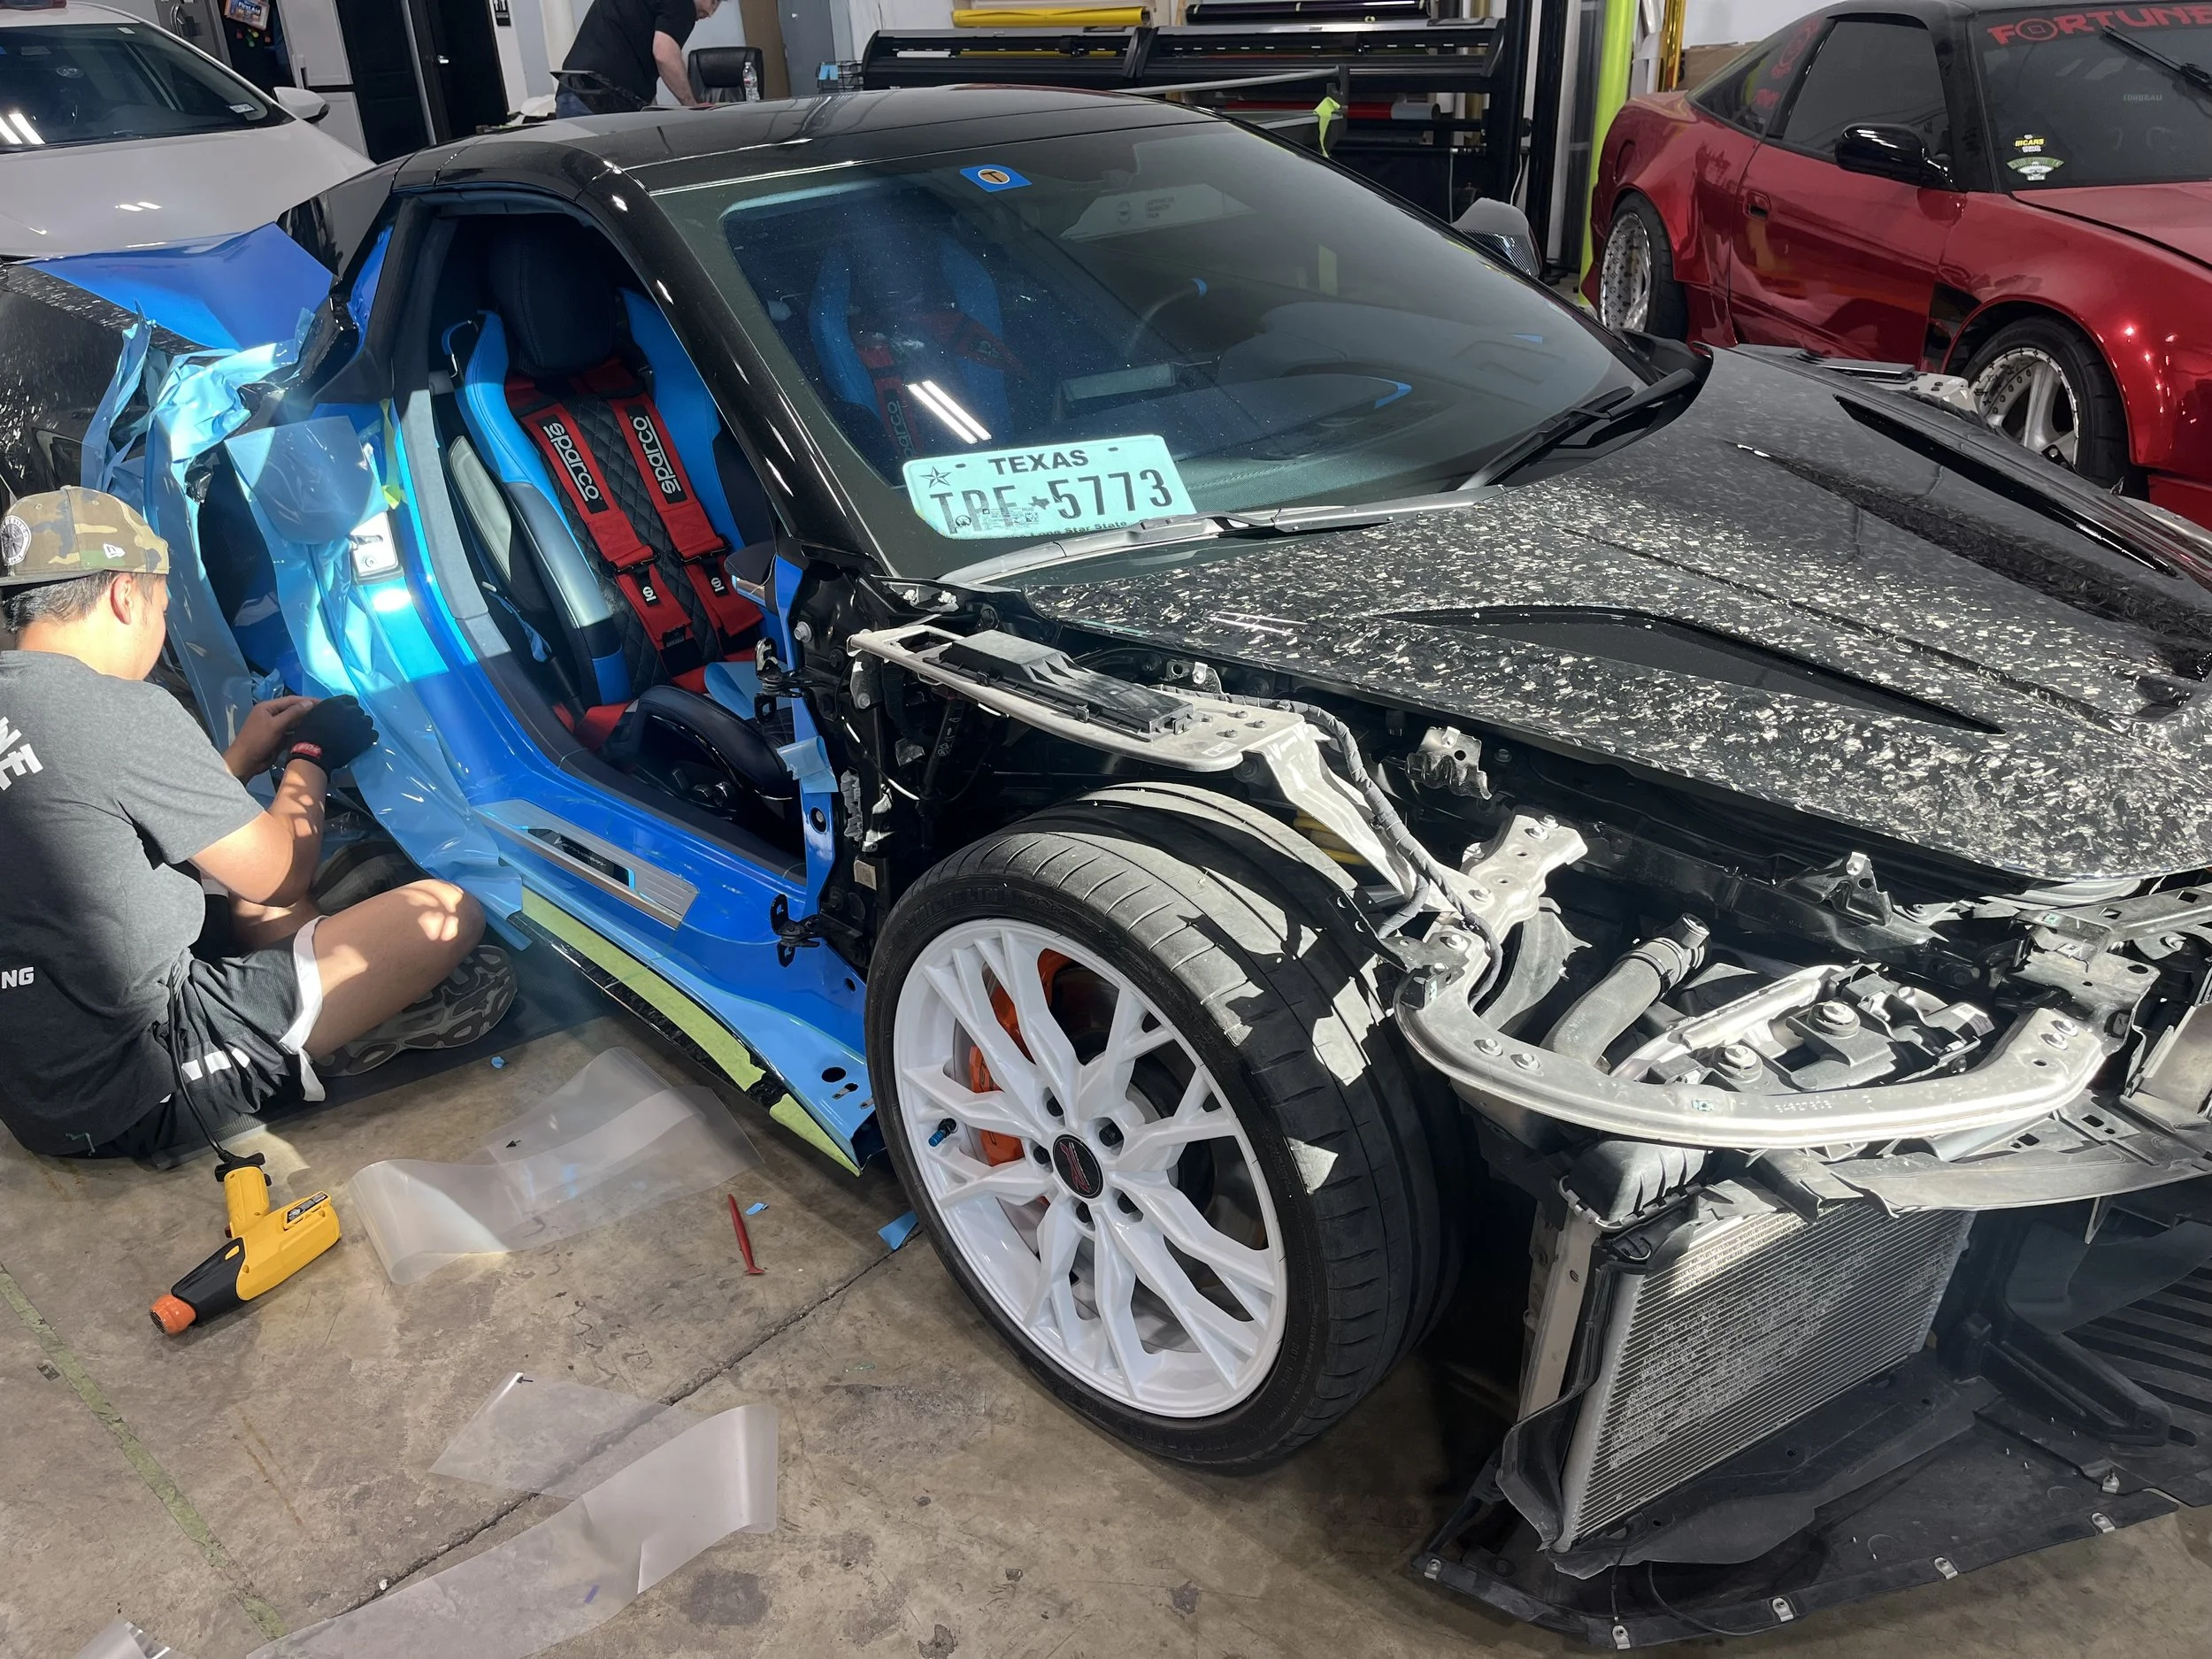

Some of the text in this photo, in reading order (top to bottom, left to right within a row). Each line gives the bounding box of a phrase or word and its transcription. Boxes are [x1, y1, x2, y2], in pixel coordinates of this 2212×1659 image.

[981, 171, 1003, 182] T
[542, 422, 601, 502] sparco
[632, 415, 682, 495] sparco
[987, 449, 1089, 475] TEXAS
[1048, 469, 1173, 519] 5773
[1, 967, 35, 989] NG
